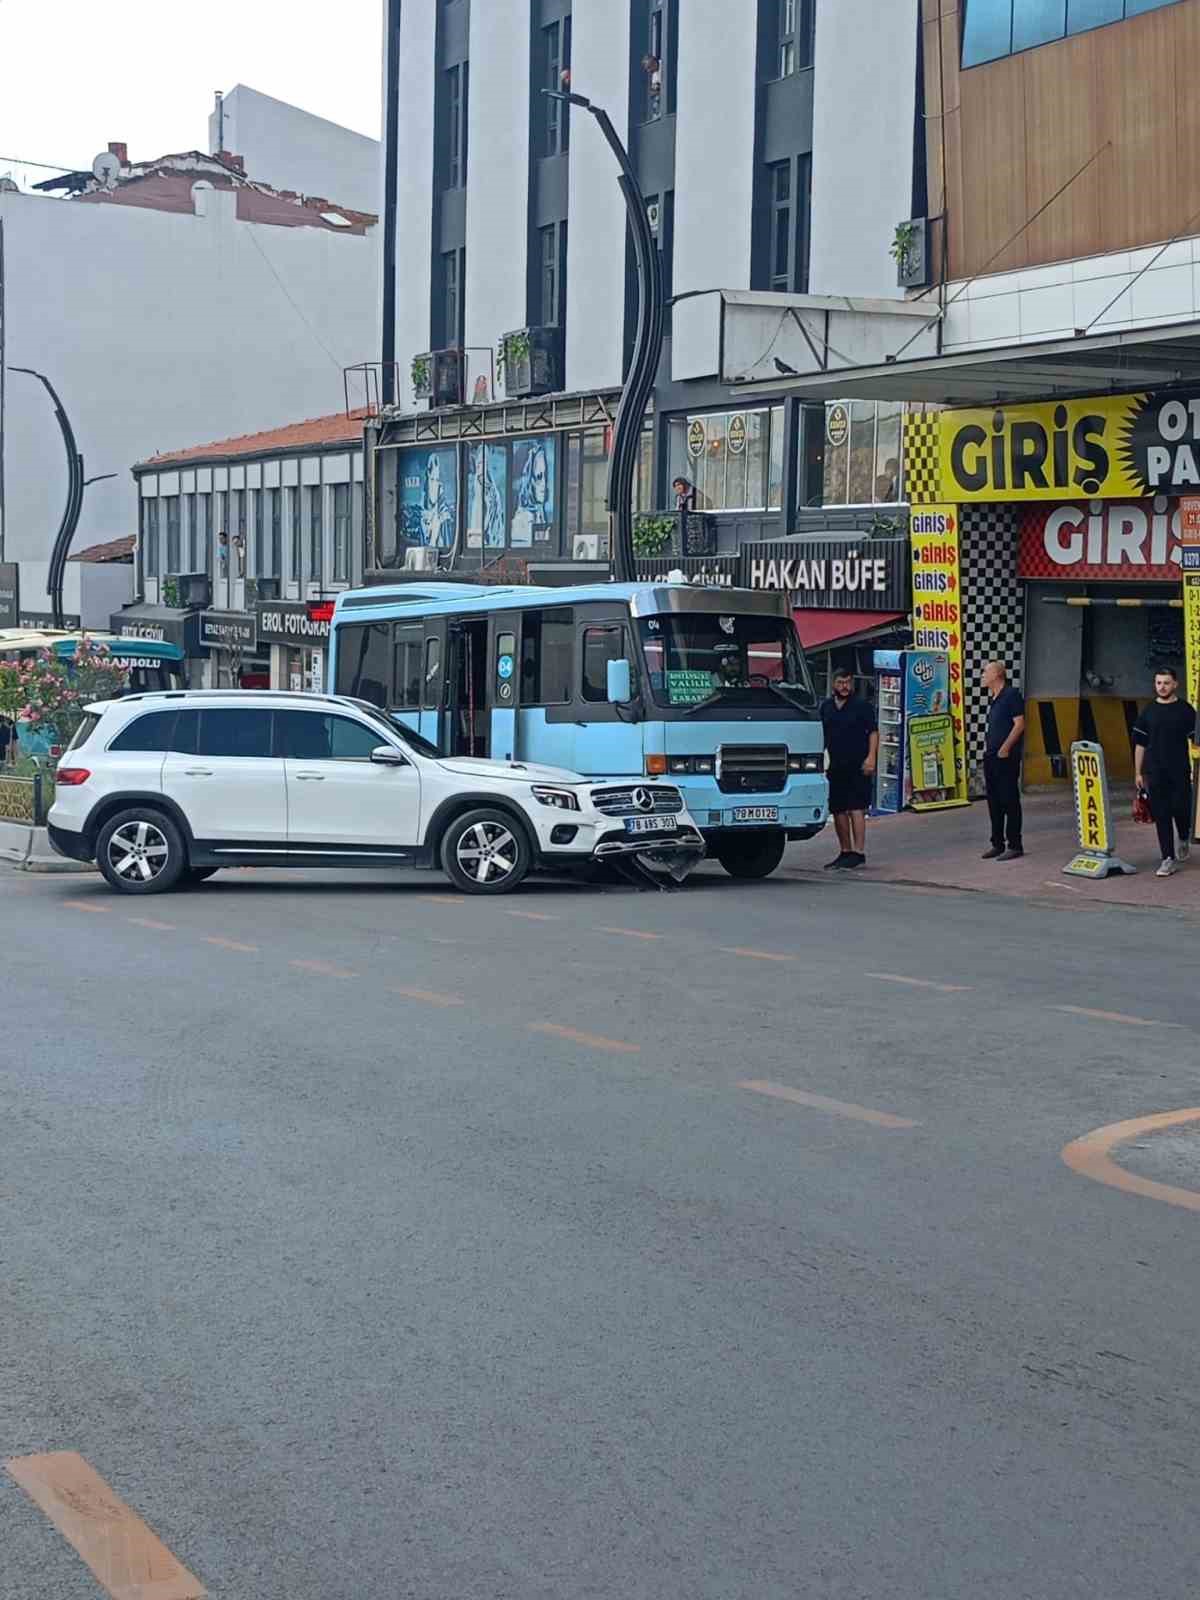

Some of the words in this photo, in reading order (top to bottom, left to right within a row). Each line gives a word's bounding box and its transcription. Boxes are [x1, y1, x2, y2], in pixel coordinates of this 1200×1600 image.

[951, 404, 1109, 495] GİRİŞ
[912, 512, 945, 535] GİRİŞ
[921, 543, 956, 566] GİRİŞ
[751, 560, 826, 589] HAKAN
[831, 550, 886, 591] BÜFE
[914, 570, 947, 592] GİRİŞ
[262, 612, 283, 632] EROL
[923, 600, 958, 624] GİRİŞ
[916, 627, 948, 650] GİRİŞ
[1077, 755, 1099, 777] OTO
[1085, 778, 1099, 845] PARK
